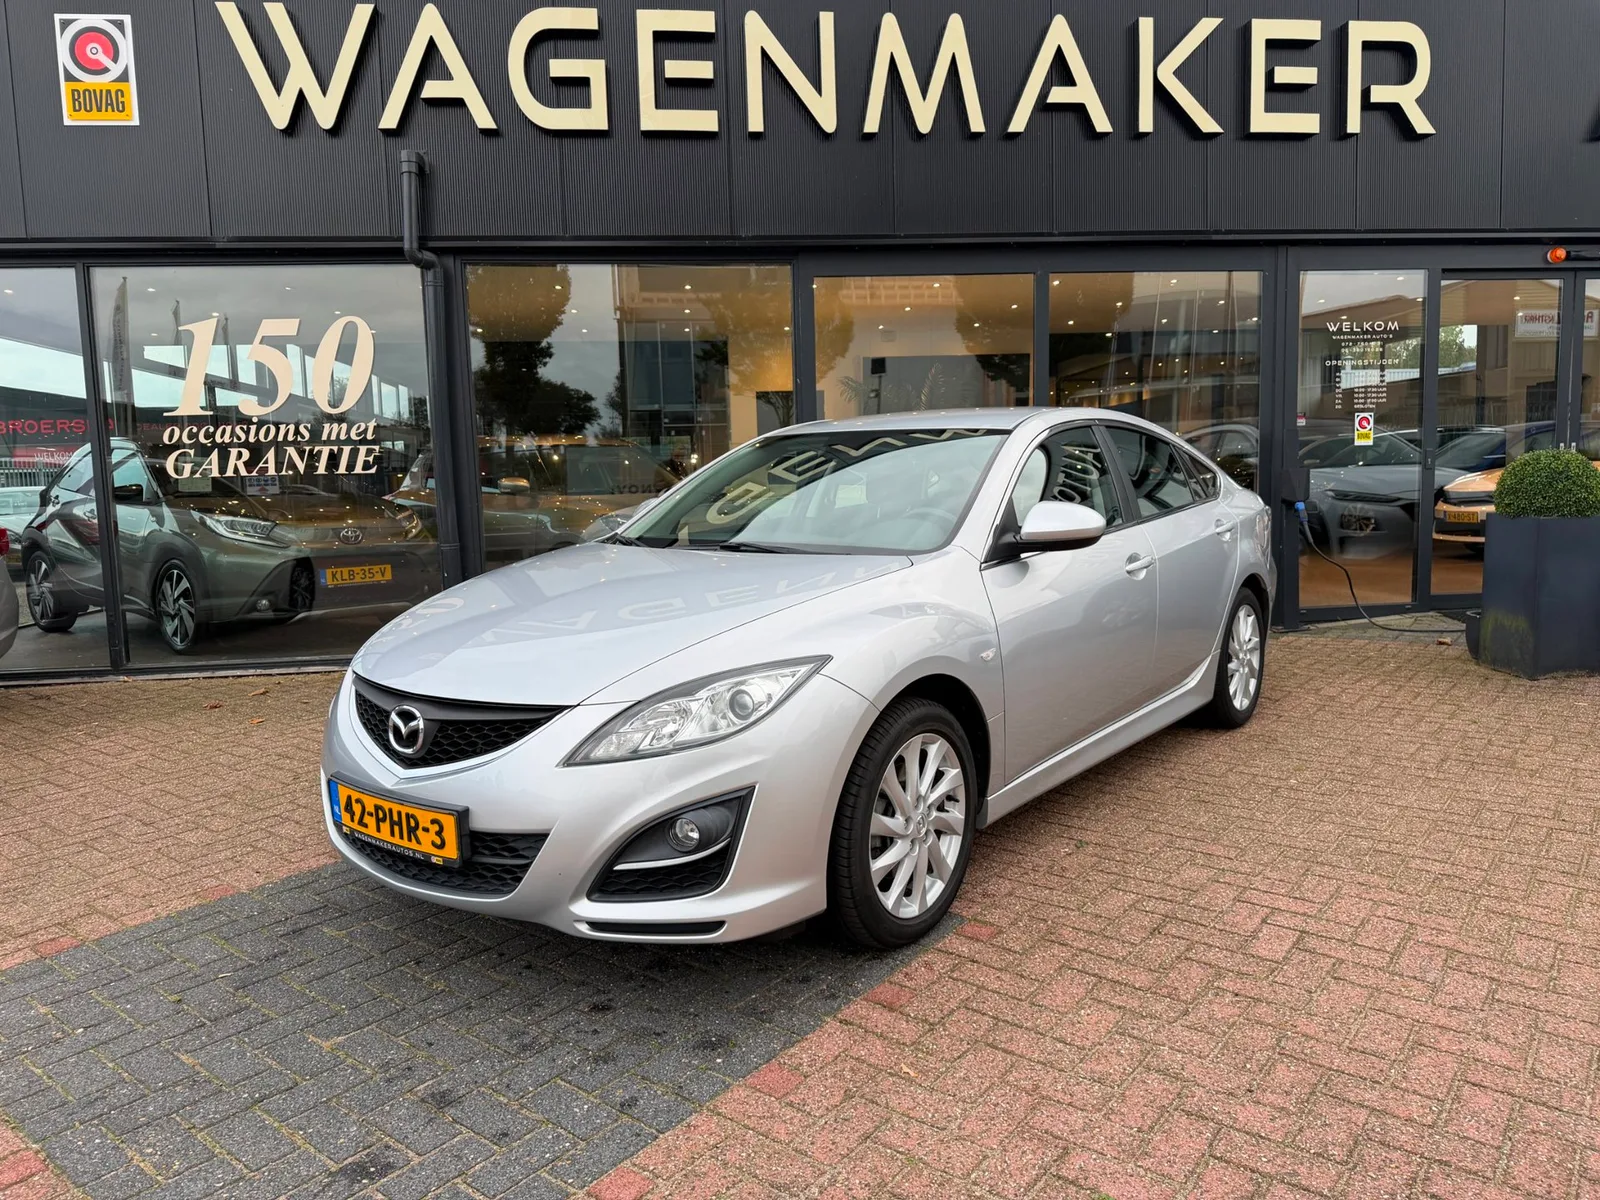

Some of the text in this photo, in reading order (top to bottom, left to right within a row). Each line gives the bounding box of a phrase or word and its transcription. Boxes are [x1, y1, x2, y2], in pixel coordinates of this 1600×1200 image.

[215, 1, 1436, 134] WAGENMAKER
[71, 89, 125, 113] BOVAG
[1326, 321, 1399, 332] WELKOM
[163, 315, 374, 416] 150
[1325, 359, 1399, 367] OPENINGSTIJDEN
[162, 416, 377, 445] occasions met
[166, 445, 380, 479] GARANTIE
[331, 566, 387, 582] KLB-35-V
[343, 794, 446, 850] 42-PHR-3
[354, 831, 425, 860] WAGENMAKERAUTOS.NL
